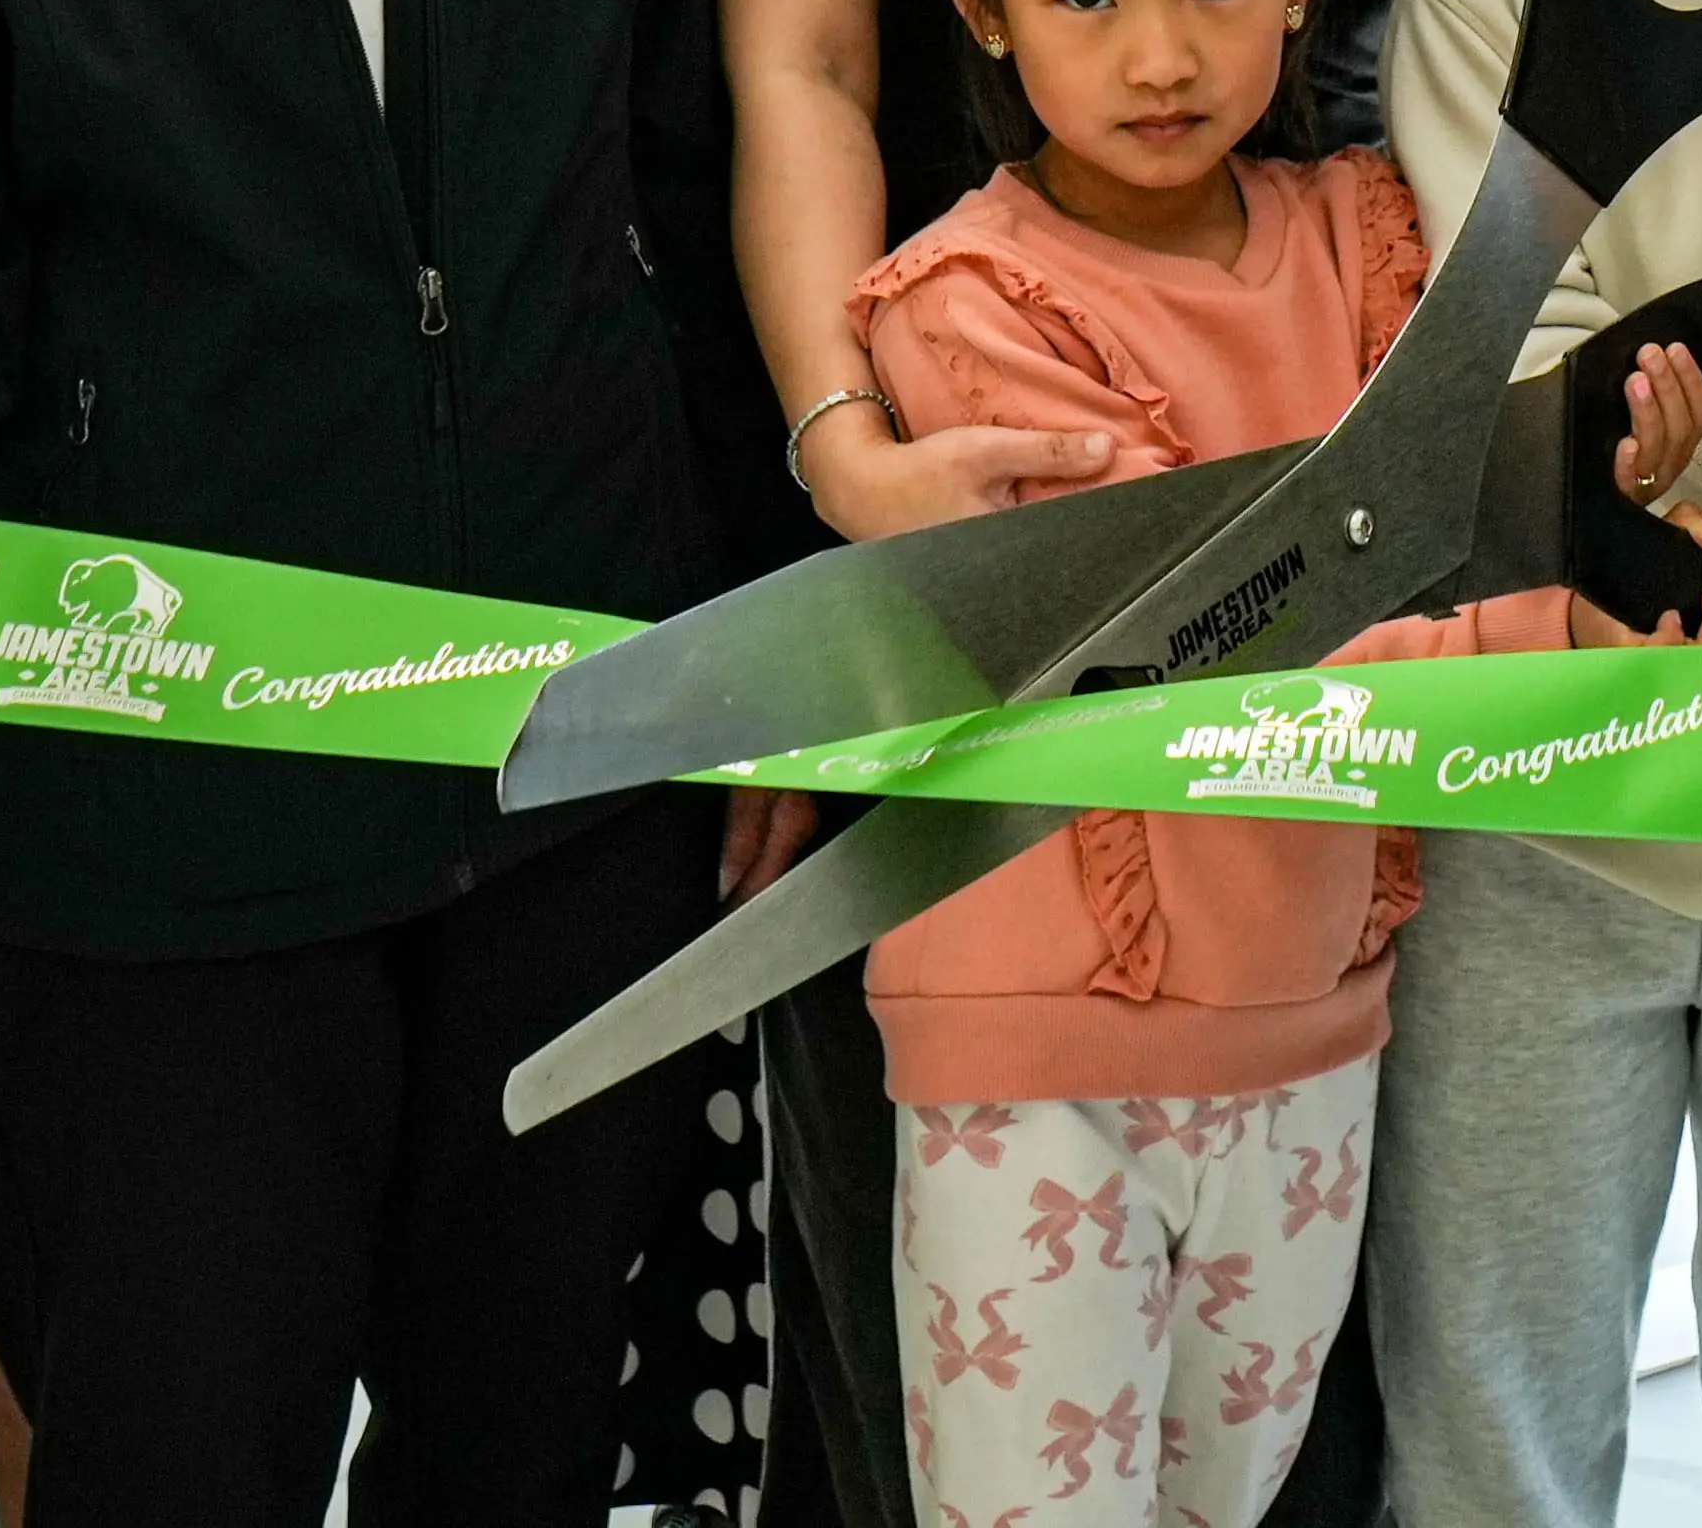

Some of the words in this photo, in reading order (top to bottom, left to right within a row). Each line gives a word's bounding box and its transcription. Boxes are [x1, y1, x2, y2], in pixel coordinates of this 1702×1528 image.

[1167, 543, 1307, 671] JAMESTOWN
[1217, 607, 1274, 663] AREA
[39, 666, 129, 697] AREA
[221, 638, 575, 711] Congratulations
[1165, 727, 1417, 766] JAMESTOWN
[1234, 759, 1334, 786] AREA
